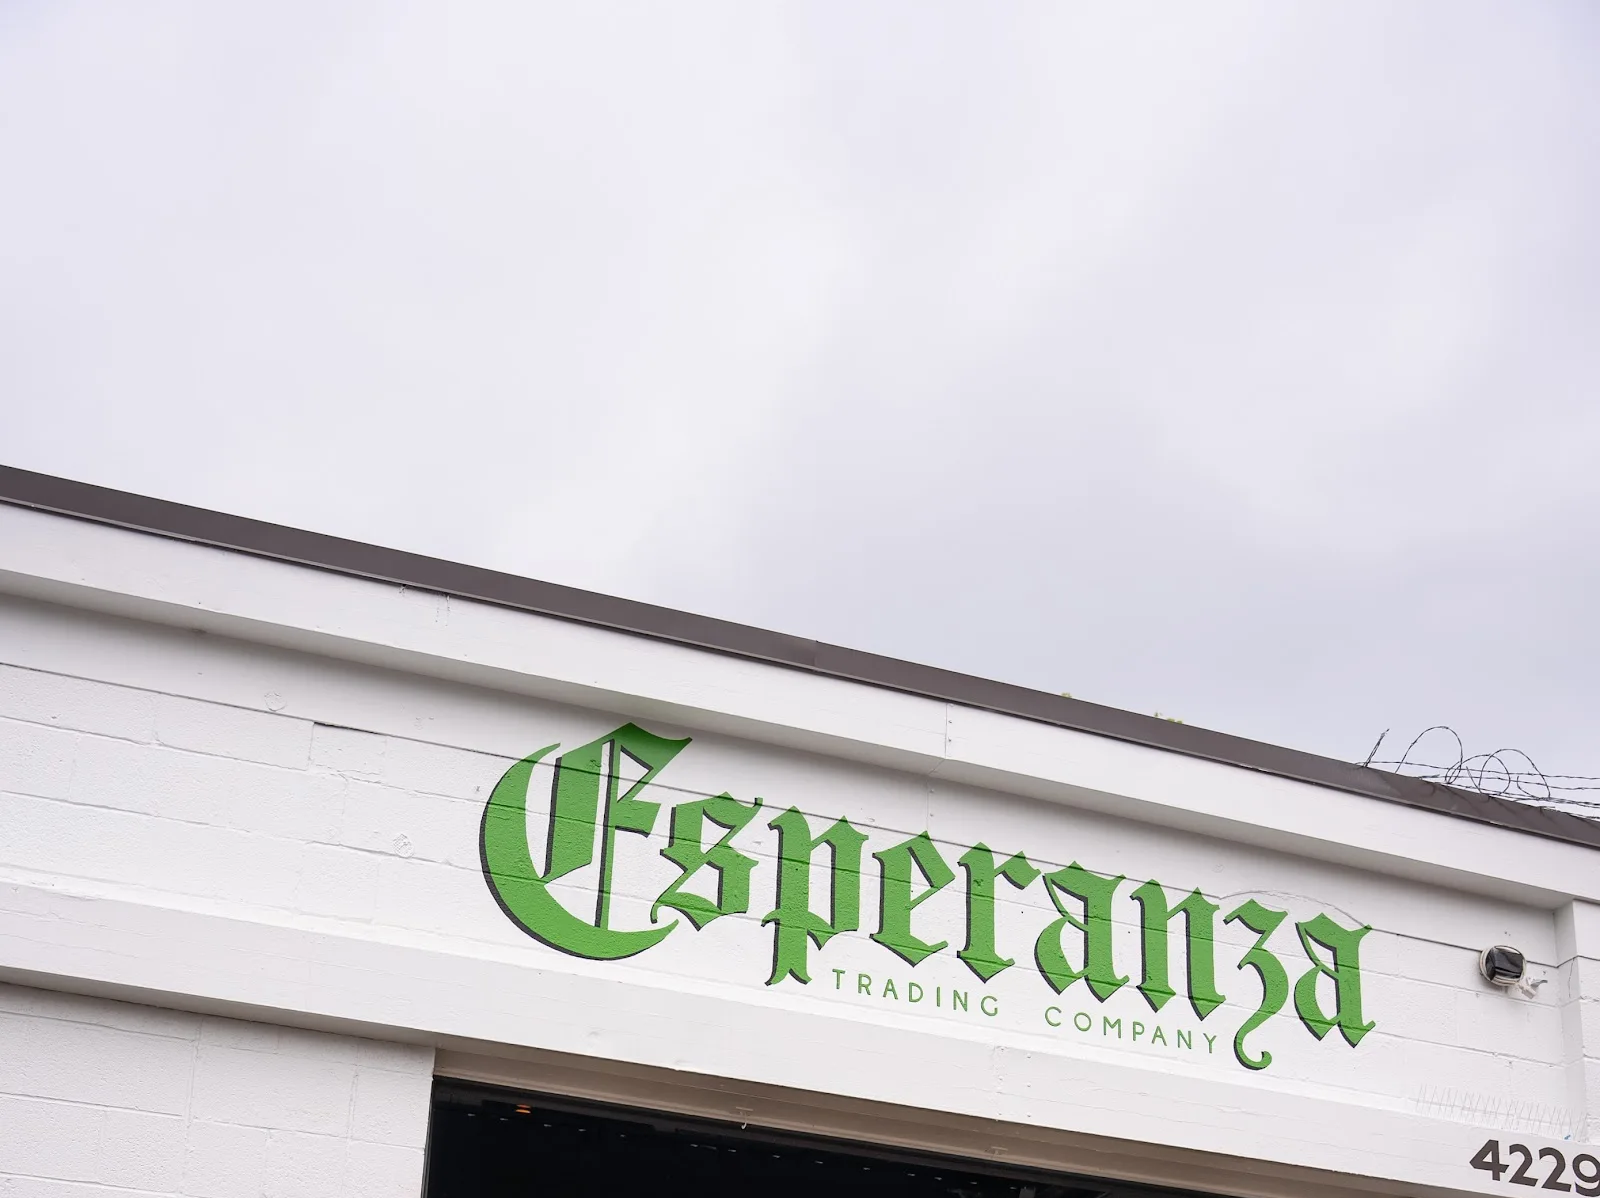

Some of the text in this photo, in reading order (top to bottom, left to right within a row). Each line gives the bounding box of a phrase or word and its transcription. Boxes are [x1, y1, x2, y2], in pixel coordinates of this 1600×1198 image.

[479, 722, 1376, 1070] Esperanza
[832, 968, 1217, 1054] TRADING COMPANY
[1469, 1139, 1600, 1197] 4229
